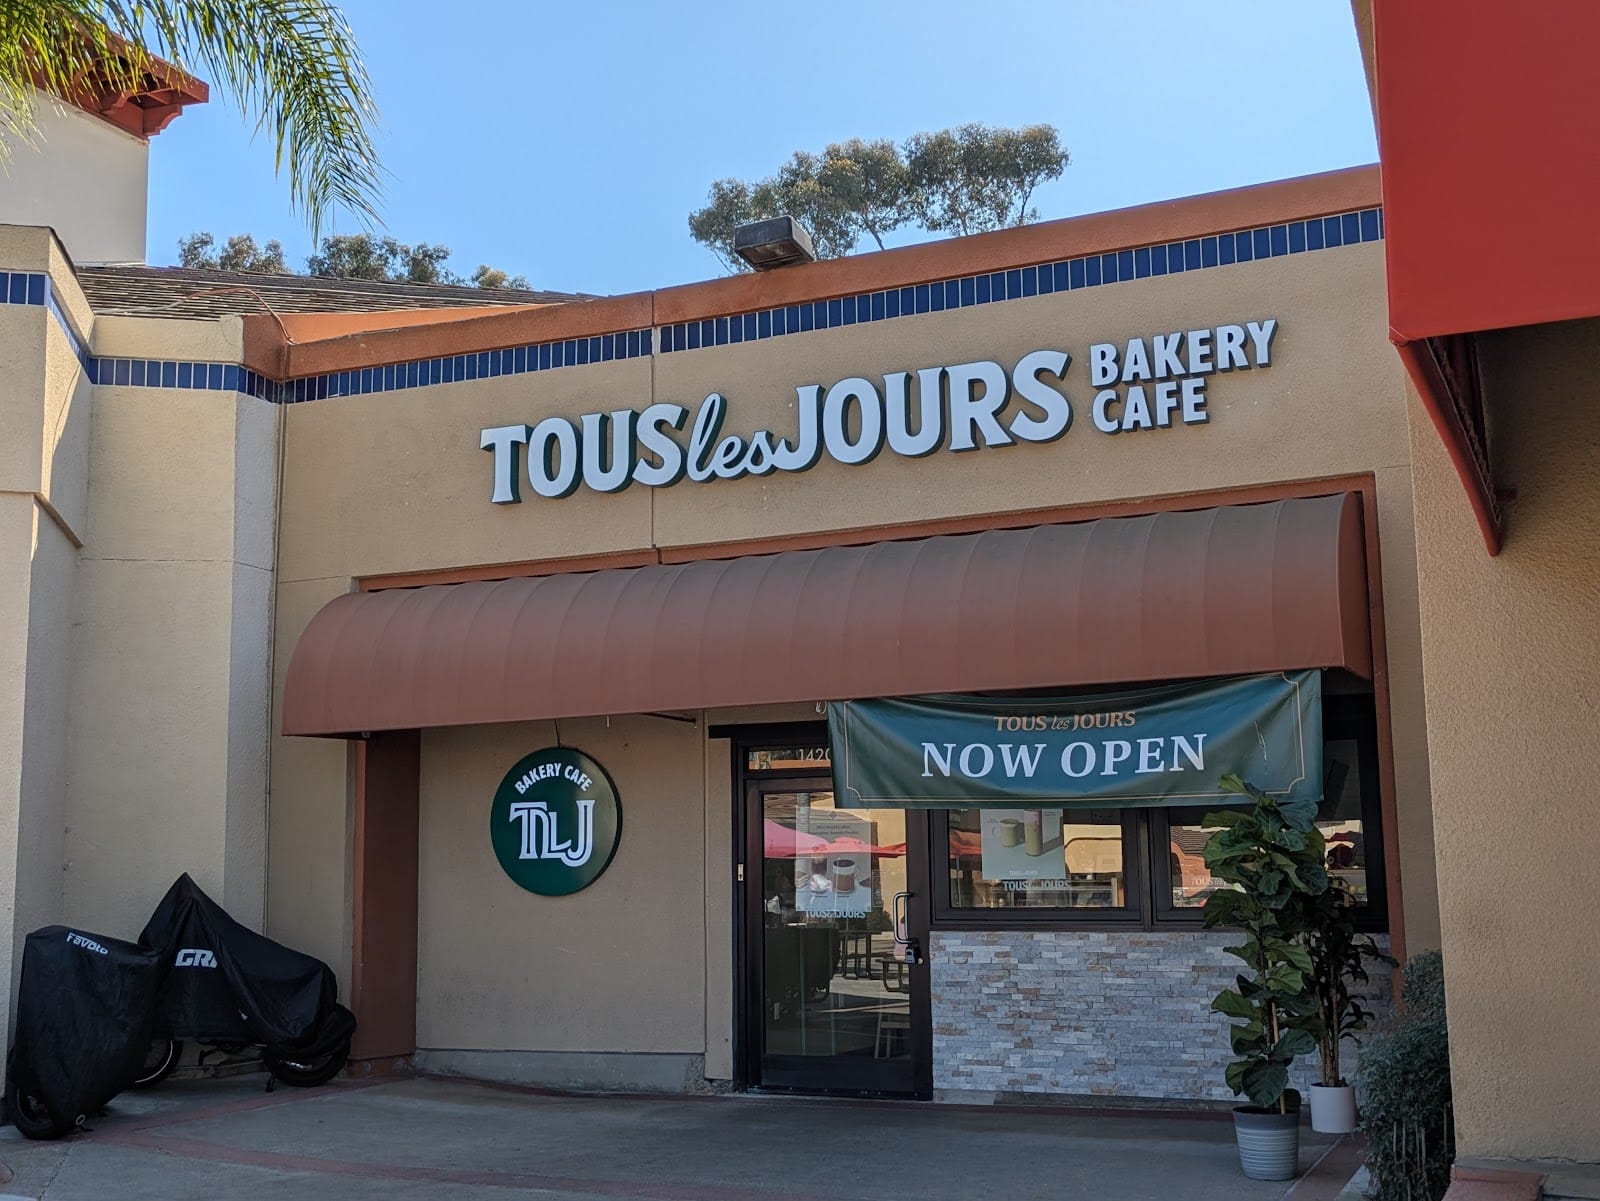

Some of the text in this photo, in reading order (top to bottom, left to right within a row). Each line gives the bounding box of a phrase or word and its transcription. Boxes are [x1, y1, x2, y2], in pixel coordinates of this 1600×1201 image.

[1090, 319, 1278, 388] BAKERY
[480, 350, 1072, 505] TOUS les JOURS
[1091, 377, 1210, 436] CAFE
[994, 712, 1136, 731] TOUS les JOURS
[514, 763, 593, 794] BAKERY CAFE
[921, 733, 1207, 777] NOW OPEN
[509, 800, 596, 867] TLJ
[1002, 880, 1028, 891] TOUS
